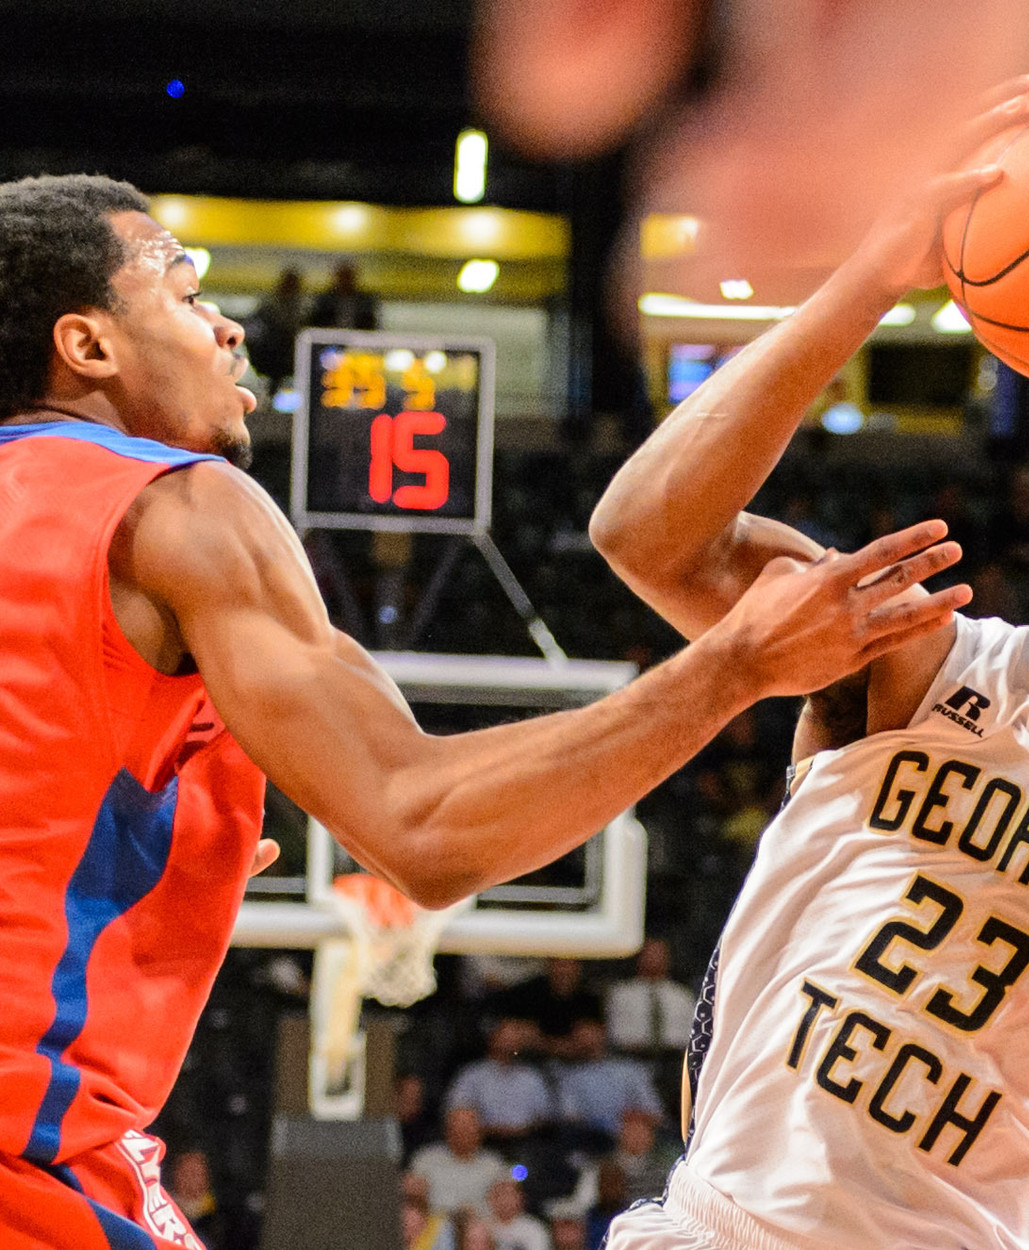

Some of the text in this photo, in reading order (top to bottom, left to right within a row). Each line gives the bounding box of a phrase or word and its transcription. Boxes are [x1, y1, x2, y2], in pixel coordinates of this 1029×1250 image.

[368, 411, 450, 510] 15
[931, 703, 984, 738] RUSSELL
[784, 978, 1003, 1167] TECH
